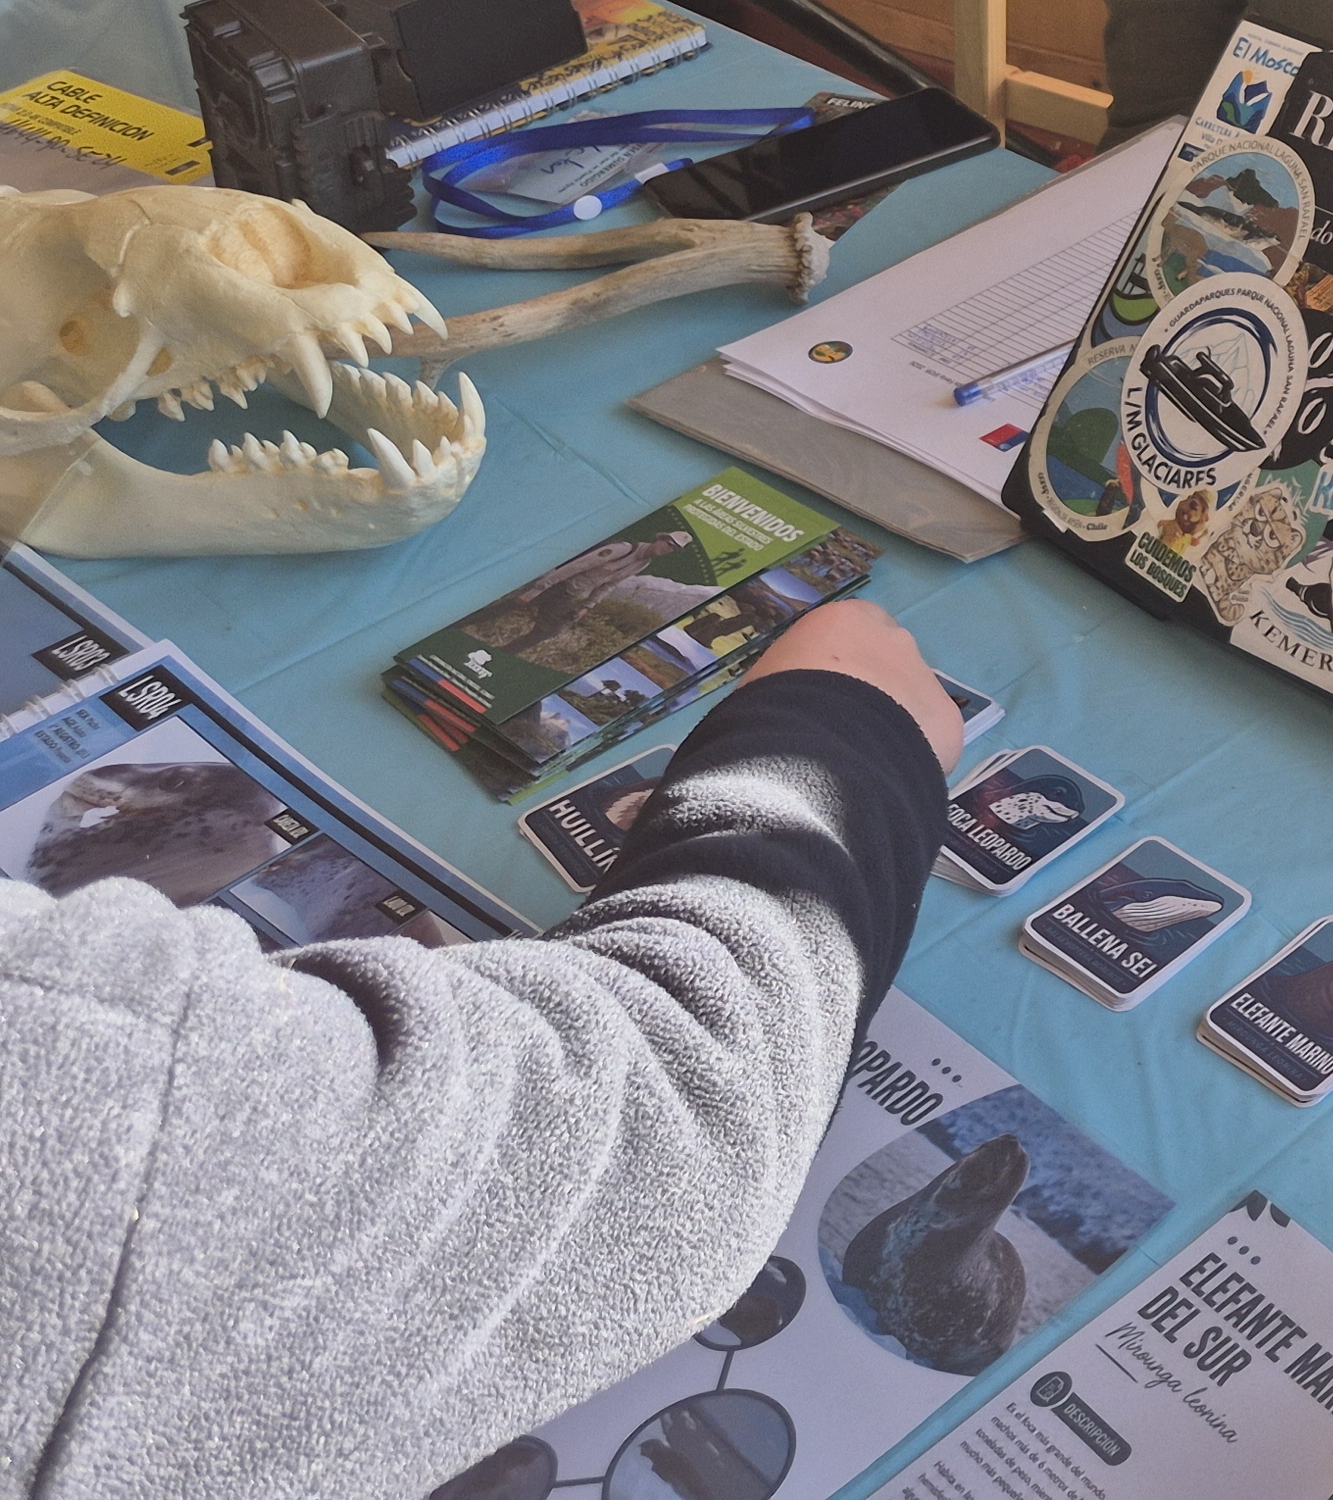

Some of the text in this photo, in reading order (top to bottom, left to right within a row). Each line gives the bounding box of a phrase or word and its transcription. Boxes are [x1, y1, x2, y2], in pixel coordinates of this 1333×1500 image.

[1232, 37, 1250, 59] El
[23, 91, 155, 141] ALTA DEFINICIÓN
[47, 81, 103, 105] CABLE
[1190, 145, 1228, 173] PARQUE
[1227, 141, 1274, 155] NACIONAL
[1274, 145, 1303, 179] LAGUNA
[1297, 177, 1308, 197] SAN
[1169, 287, 1236, 328] GUARDAPARQUES
[1236, 287, 1266, 303] PARQUE
[1264, 298, 1290, 336] NACIONAL
[1285, 334, 1295, 374] LAGUNA
[1286, 374, 1294, 392] SAN
[702, 483, 805, 542] BIENVENIDOS
[1129, 551, 1188, 600] LOS BOSQUES
[1137, 531, 1198, 583] CUIDEMOS
[51, 635, 111, 671] LSR03
[118, 675, 182, 721] LSR04
[948, 803, 1032, 871] FOCA LEOPARDO
[1051, 903, 1129, 960] BALLENA
[1121, 951, 1158, 978] SEI
[1230, 992, 1297, 1043] ELEFANTE
[1179, 1251, 1307, 1364] ELEFANTE
[1136, 1284, 1253, 1388] DEL SUR
[1104, 1320, 1240, 1447] Mirounga leonina
[960, 1440, 984, 1465] mucho
[975, 1428, 1007, 1459] toneladas
[990, 1416, 1017, 1442] machos
[1044, 1465, 1070, 1491] metros
[1021, 1414, 1036, 1435] foca
[1049, 1443, 1073, 1469] grande
[1071, 1462, 1084, 1479] del
[1063, 1402, 1121, 1457] DESCRIPCIÓN
